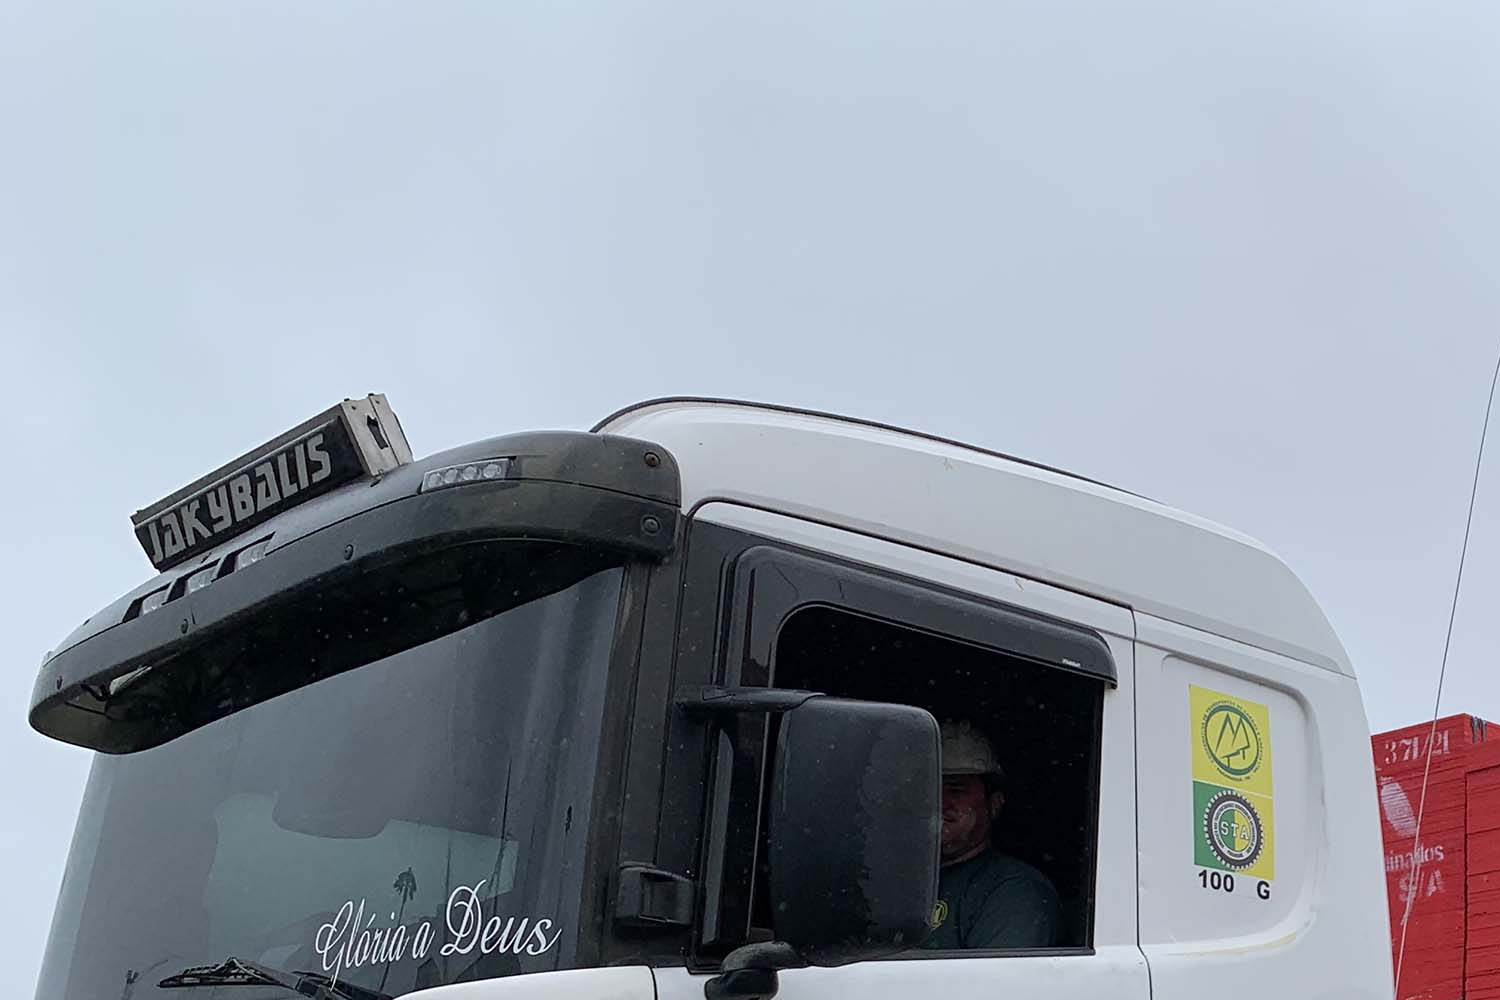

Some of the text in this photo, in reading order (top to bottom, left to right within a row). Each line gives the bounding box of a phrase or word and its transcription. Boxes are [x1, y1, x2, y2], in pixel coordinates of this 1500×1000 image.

[1385, 730, 1450, 764] 371/21
[1384, 843, 1445, 873] inados
[1199, 869, 1271, 900] 100 G
[315, 879, 562, 992] Glória a Deus
